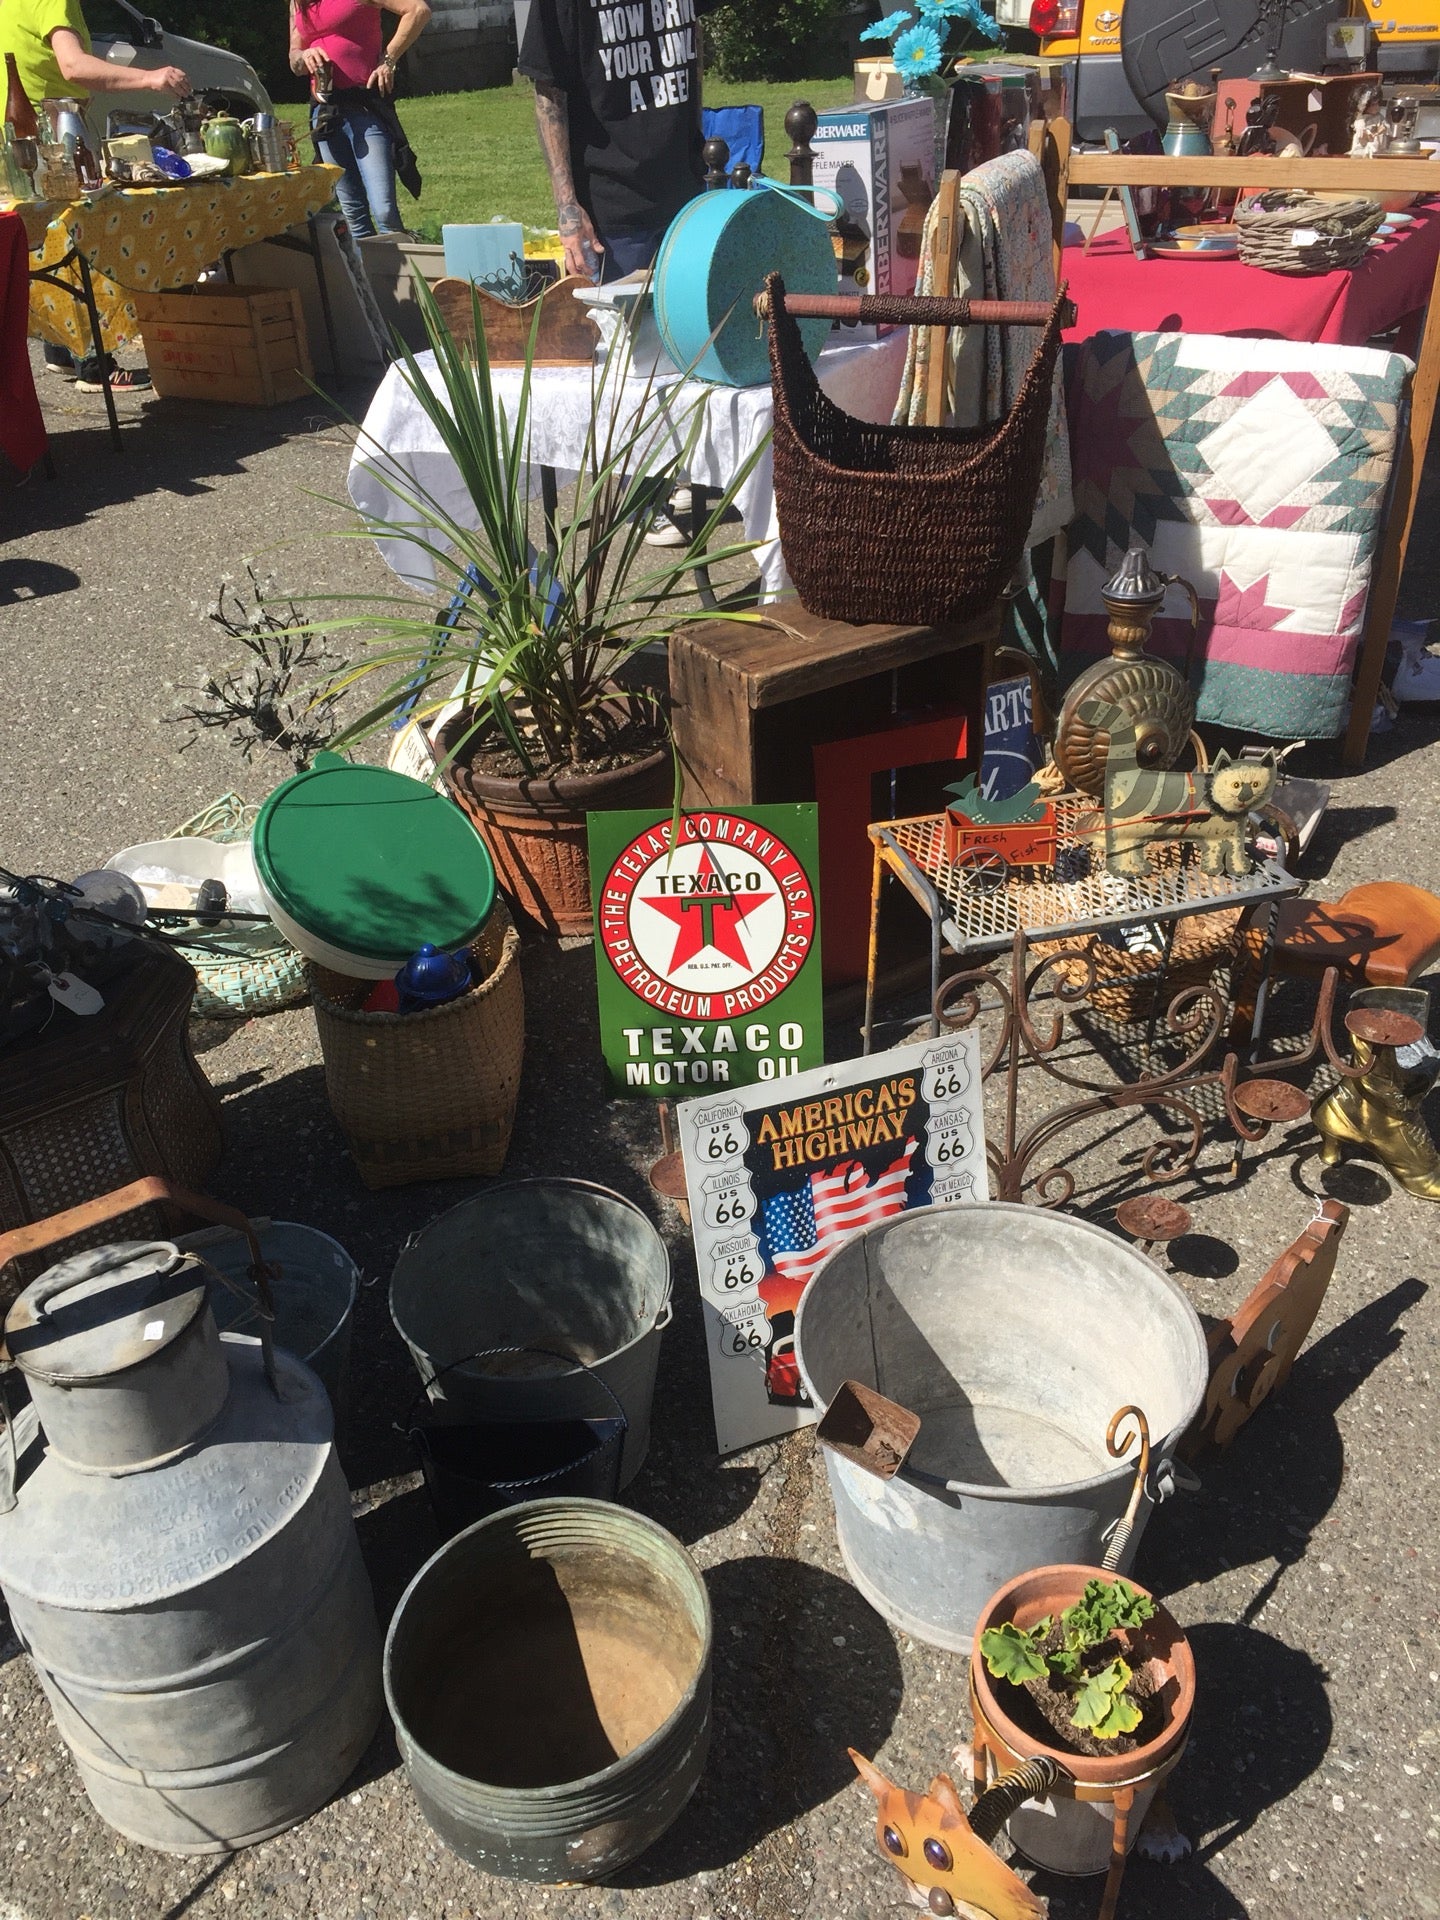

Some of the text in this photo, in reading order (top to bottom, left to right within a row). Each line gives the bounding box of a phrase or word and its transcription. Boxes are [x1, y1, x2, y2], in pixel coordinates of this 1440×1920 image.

[598, 3, 644, 44] NOW
[598, 41, 654, 81] YOUR
[630, 80, 647, 113] A
[873, 119, 892, 296] RBERWARE
[684, 816, 788, 866] COMPANY
[615, 825, 673, 882] TEXAS
[655, 871, 762, 895] TEXACO
[605, 889, 627, 929] THE
[680, 896, 735, 948] T
[608, 933, 809, 1017] PETROLEUM PRODUCTS
[622, 1022, 804, 1057] TEXACO
[931, 1047, 959, 1065] ARIZONA
[625, 1058, 730, 1086] MOTOR
[937, 1065, 954, 1075] US
[933, 1075, 962, 1099] 66
[697, 1105, 740, 1125] CALIFORNIA
[756, 1077, 917, 1146] AMERICA'S
[932, 1110, 965, 1130] KANSAS
[711, 1123, 730, 1134] US
[771, 1108, 909, 1171] HIGHWAY
[941, 1129, 959, 1140] US
[708, 1135, 739, 1160] 66
[937, 1140, 966, 1164] 66
[711, 1173, 742, 1192] ILLINOIS
[933, 1175, 971, 1195] NEW MEXICO
[718, 1189, 738, 1201] US
[944, 1192, 962, 1203] US
[715, 1201, 747, 1225] 66
[717, 1237, 752, 1257] MISSOURI
[726, 1254, 746, 1266] US
[723, 1268, 755, 1290] 66
[723, 1302, 763, 1324] OKLAHOMA
[735, 1319, 754, 1330] US
[732, 1331, 763, 1354] 66
